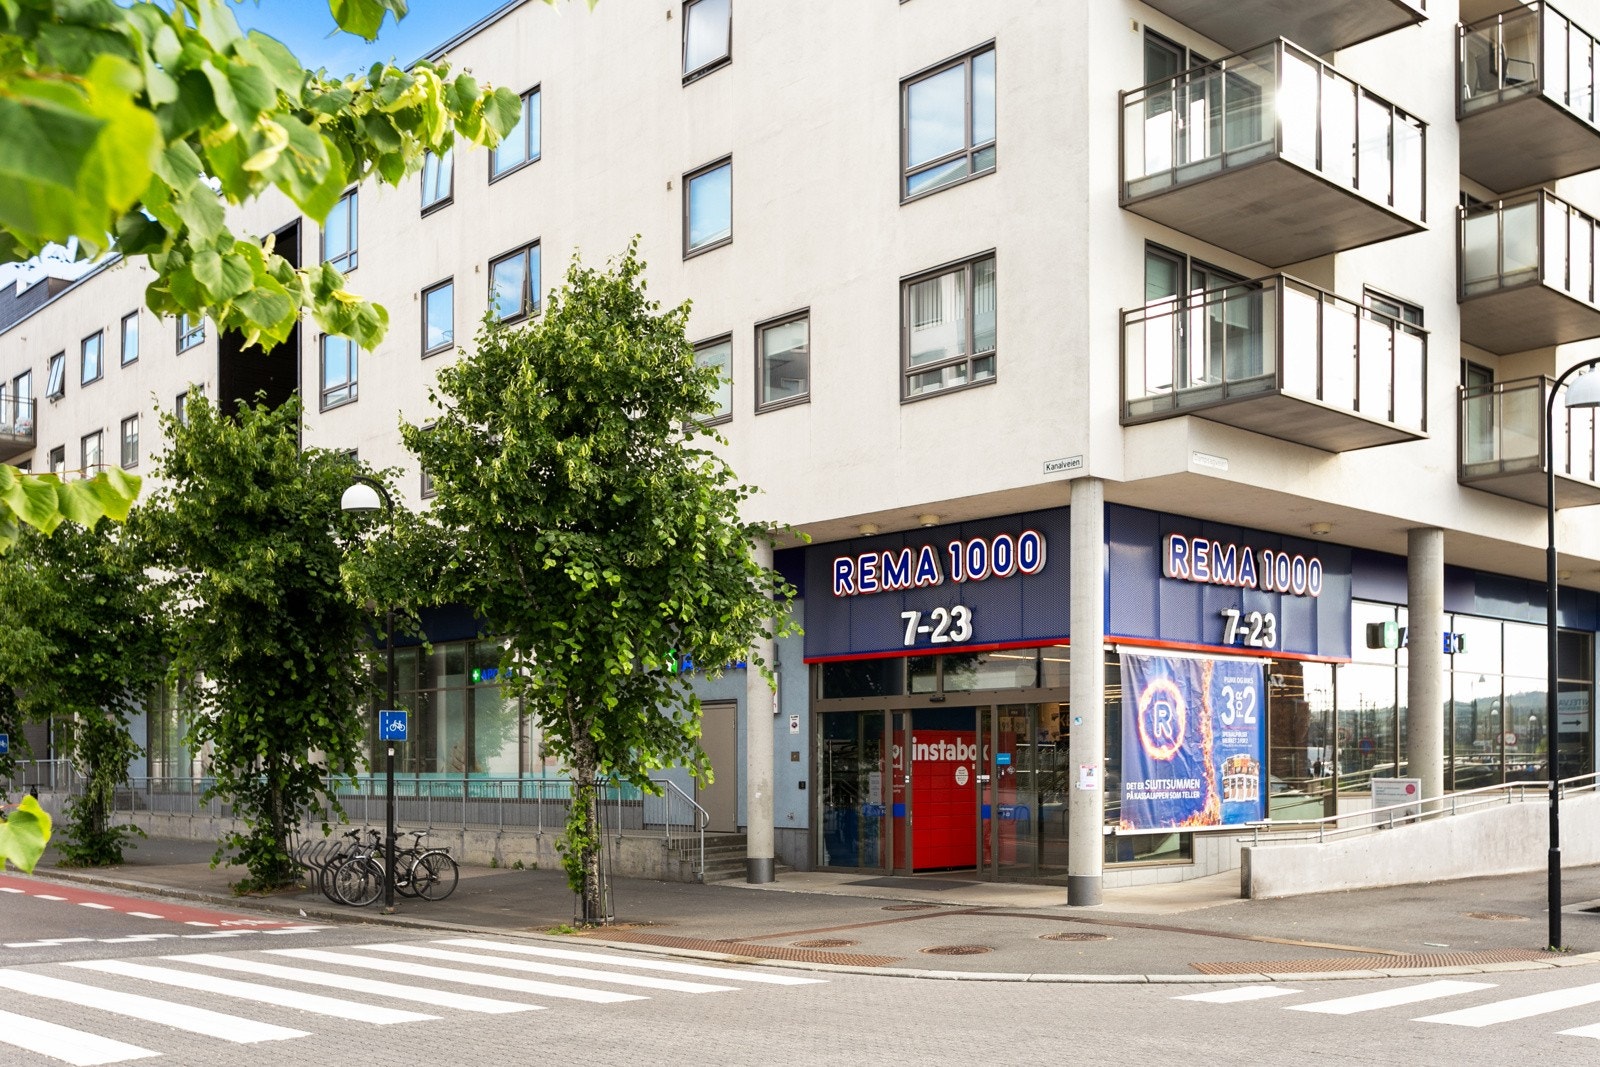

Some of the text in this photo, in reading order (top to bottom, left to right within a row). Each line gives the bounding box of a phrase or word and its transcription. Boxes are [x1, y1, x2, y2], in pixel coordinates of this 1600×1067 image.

[1045, 459, 1081, 472] Kanalveien
[834, 530, 1046, 597] REMA 1000
[1164, 533, 1323, 597] REMA 1000
[901, 605, 973, 646] 7-23
[1220, 608, 1277, 649] 7-23
[1154, 701, 1173, 738] R
[1221, 685, 1235, 725] 3
[1243, 686, 1256, 724] 2
[1126, 778, 1200, 790] DET ER SLUTTSUMMEN
[1126, 790, 1200, 800] PÅ KASSALAPPEN SOM TELLER
